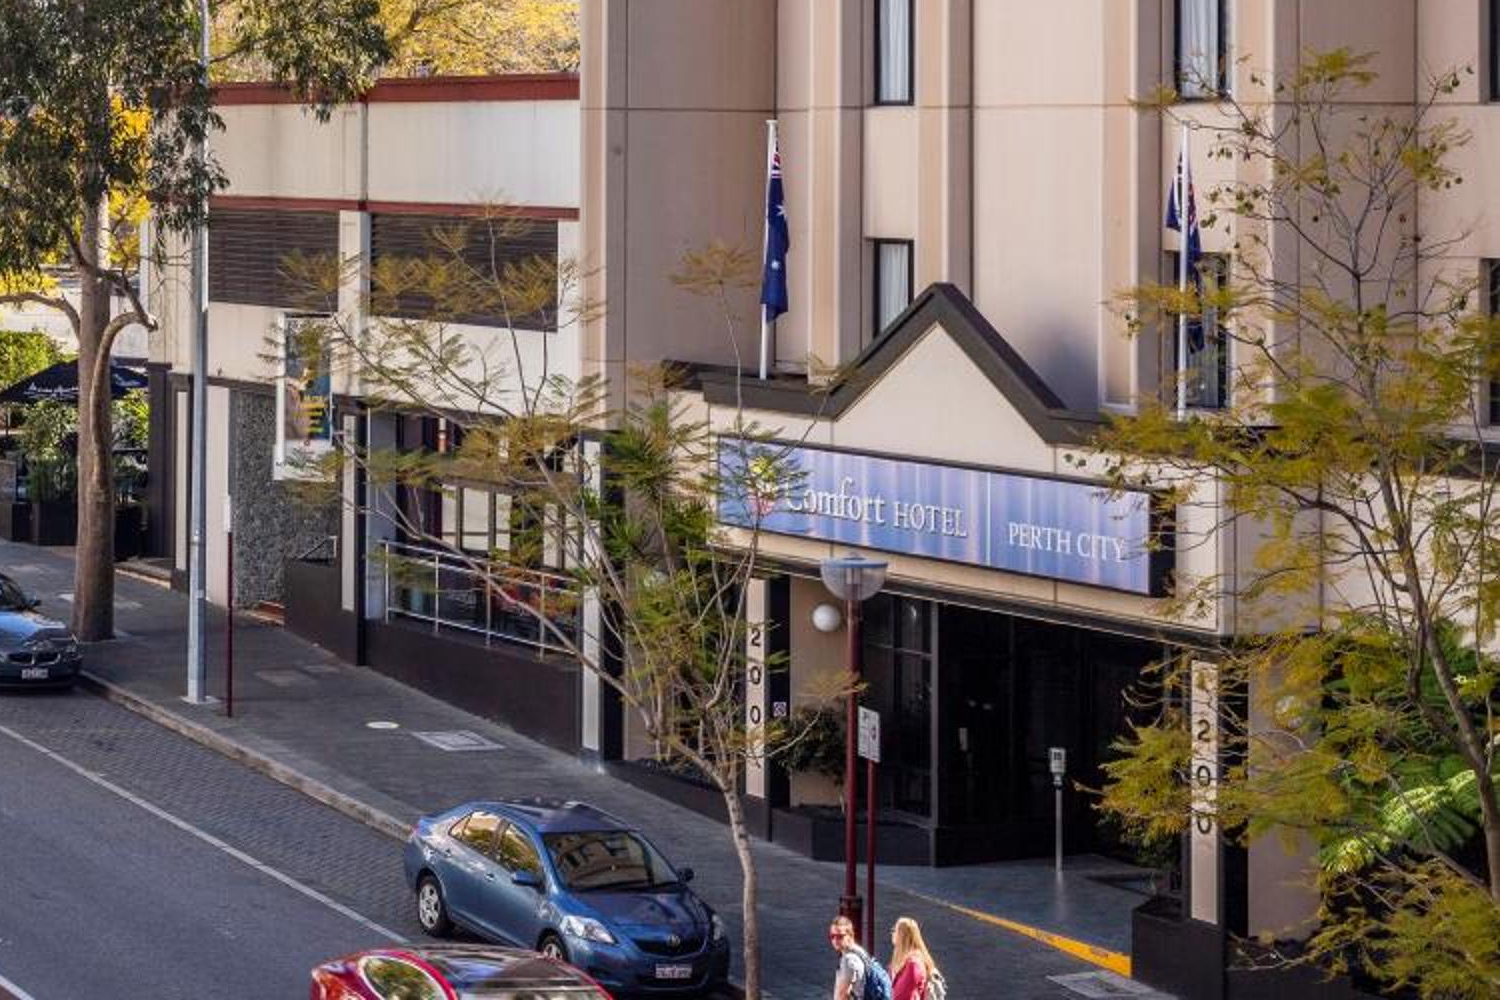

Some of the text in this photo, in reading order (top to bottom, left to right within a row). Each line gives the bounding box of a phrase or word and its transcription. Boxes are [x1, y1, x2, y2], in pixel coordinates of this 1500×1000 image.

[786, 476, 968, 538] Comfort HOTEL
[1008, 521, 1126, 563] PERTH CITY
[749, 626, 762, 725] 200
[1197, 718, 1212, 835] 200
